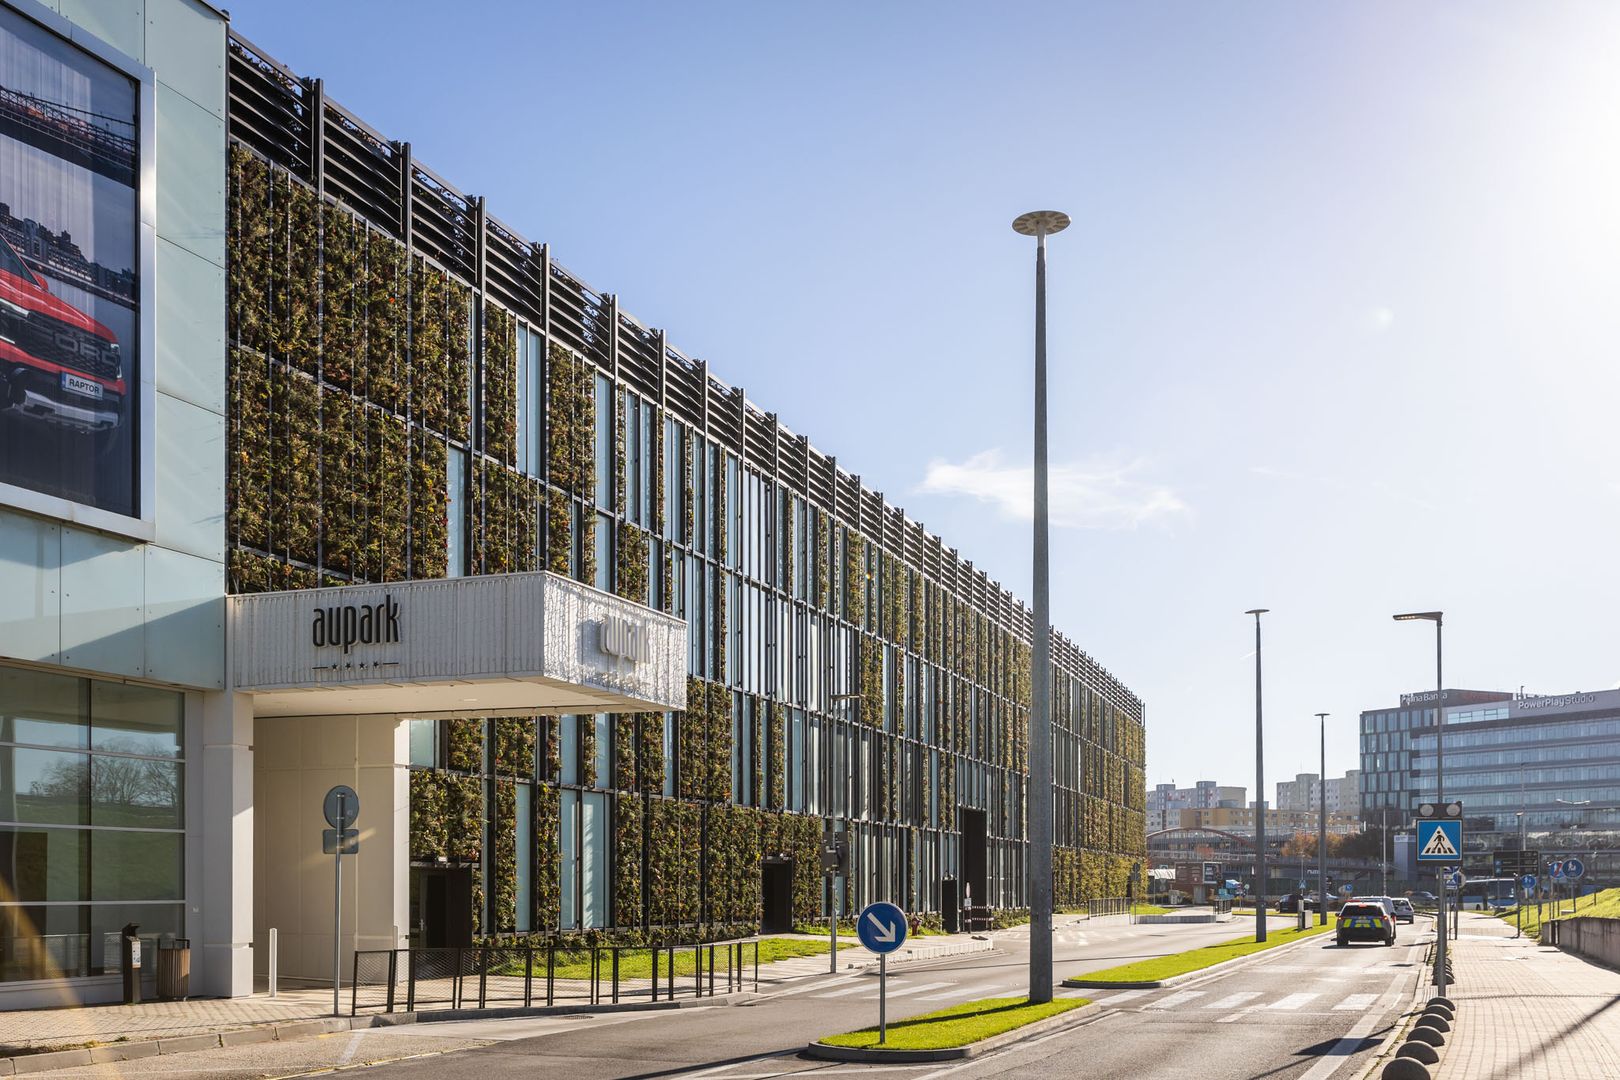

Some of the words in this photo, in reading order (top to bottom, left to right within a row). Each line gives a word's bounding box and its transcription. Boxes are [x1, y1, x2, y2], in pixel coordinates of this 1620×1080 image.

[69, 378, 100, 394] RAPTOR
[312, 594, 399, 655] aupark
[1423, 692, 1448, 701] Bana
[1518, 694, 1594, 709] PowerPlayStudio
